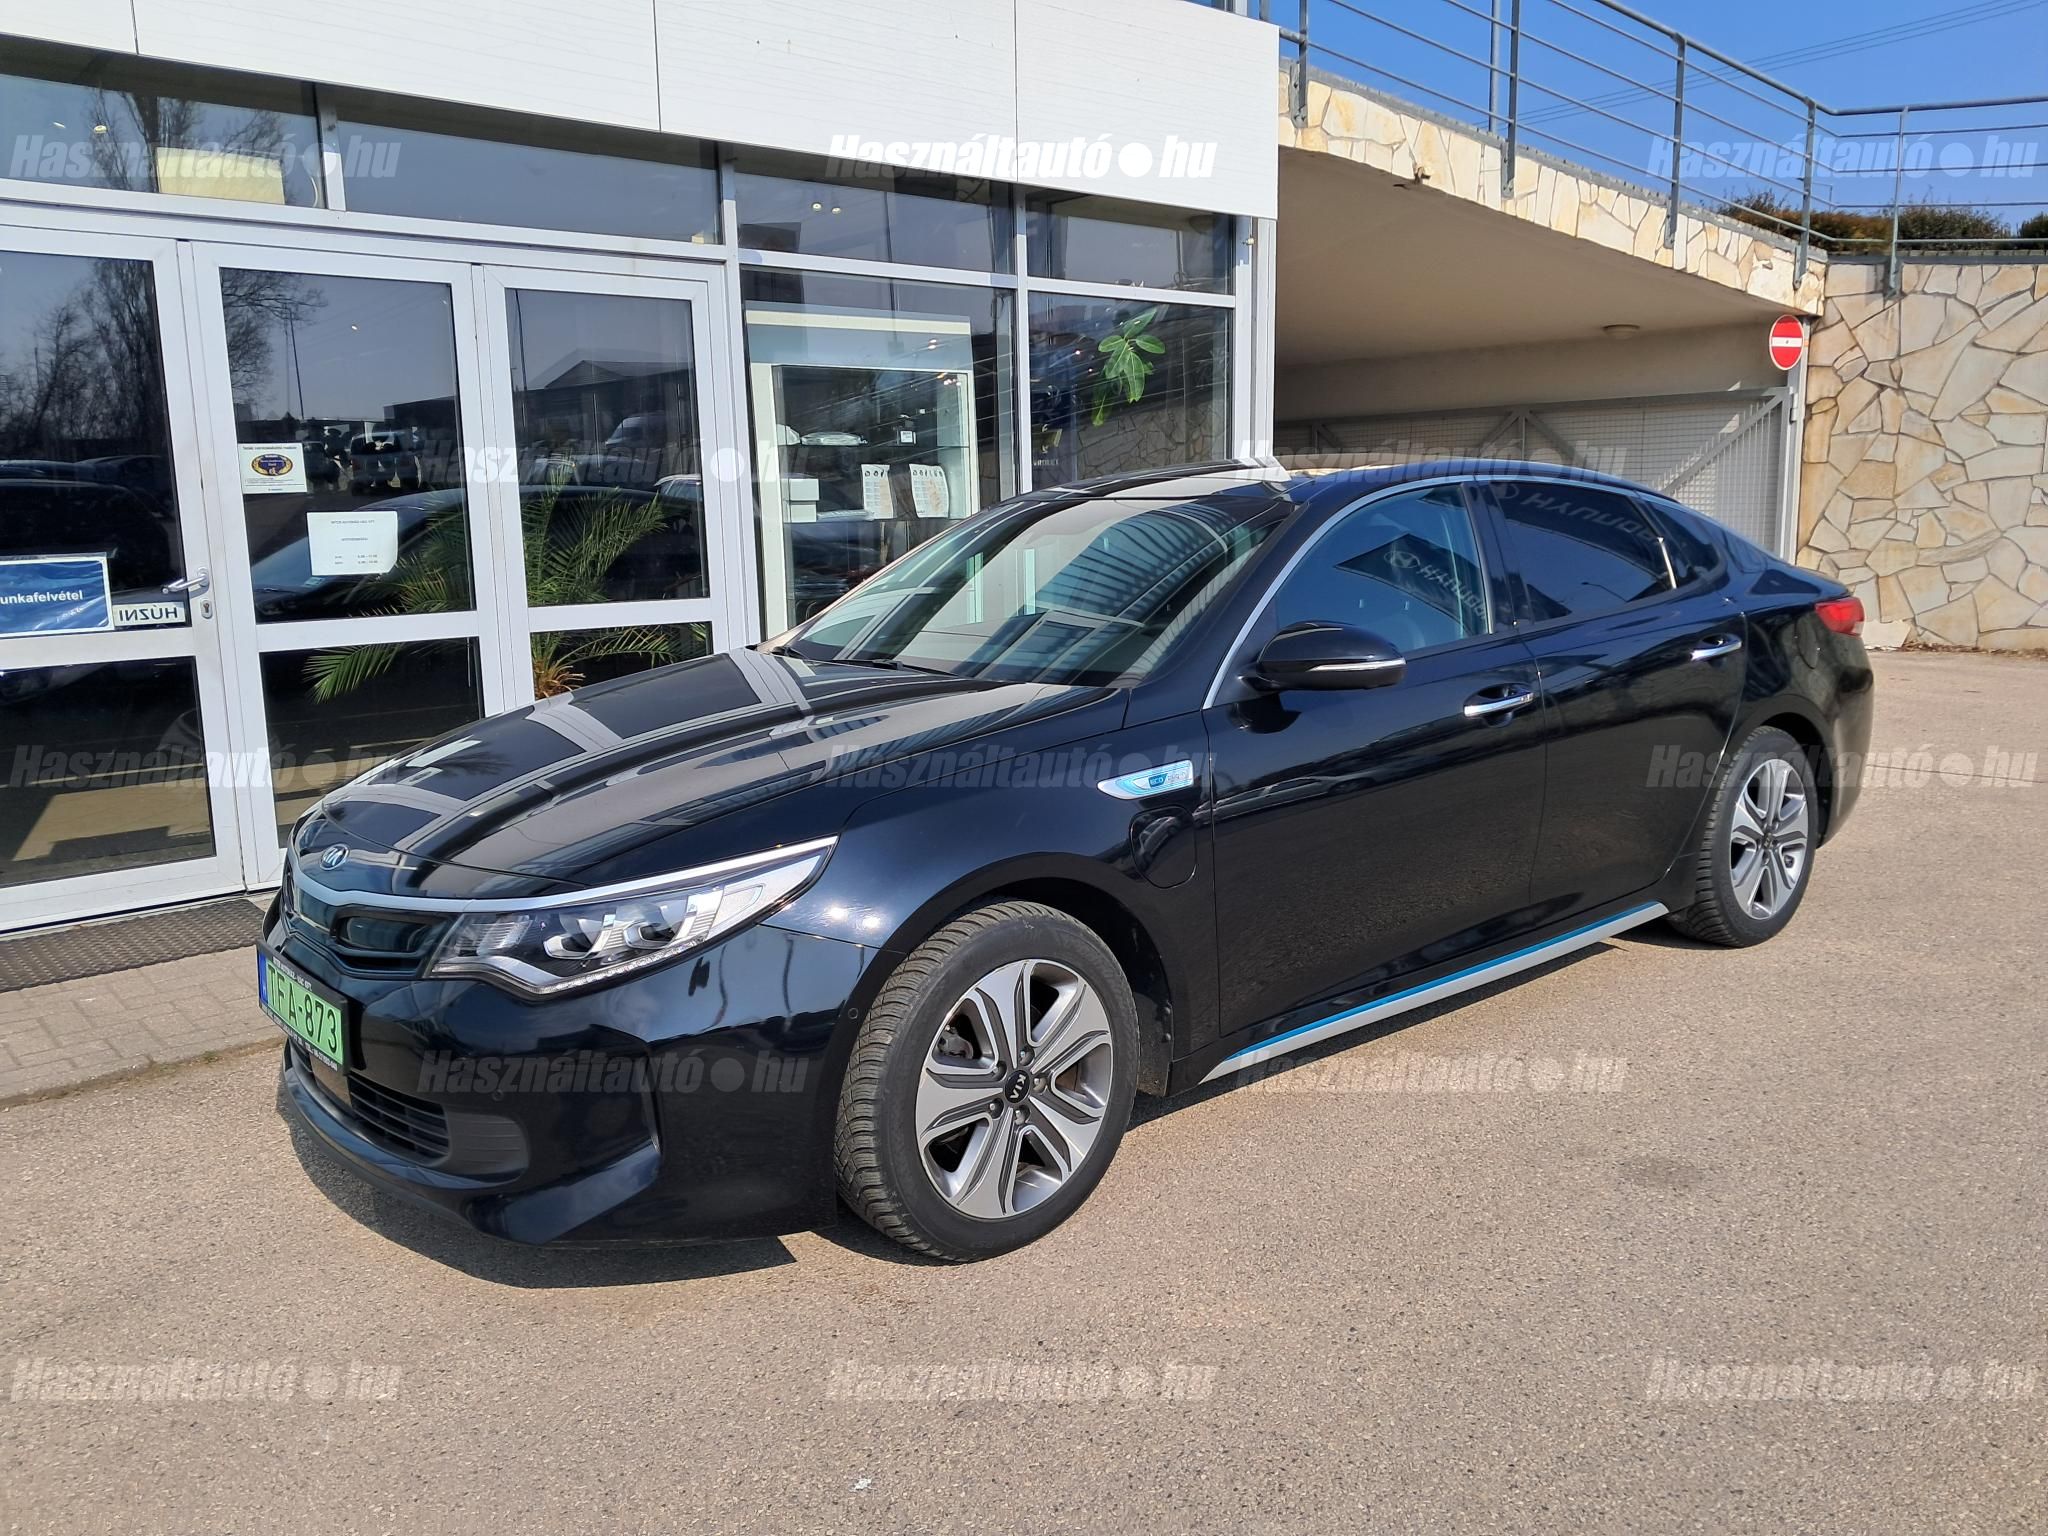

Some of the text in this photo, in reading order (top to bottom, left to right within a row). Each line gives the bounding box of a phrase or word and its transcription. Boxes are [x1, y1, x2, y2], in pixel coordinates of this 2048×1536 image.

[0, 589, 84, 606] unkafelvétel
[268, 963, 338, 1054] TFA-873
[1009, 1073, 1027, 1099] KIA
